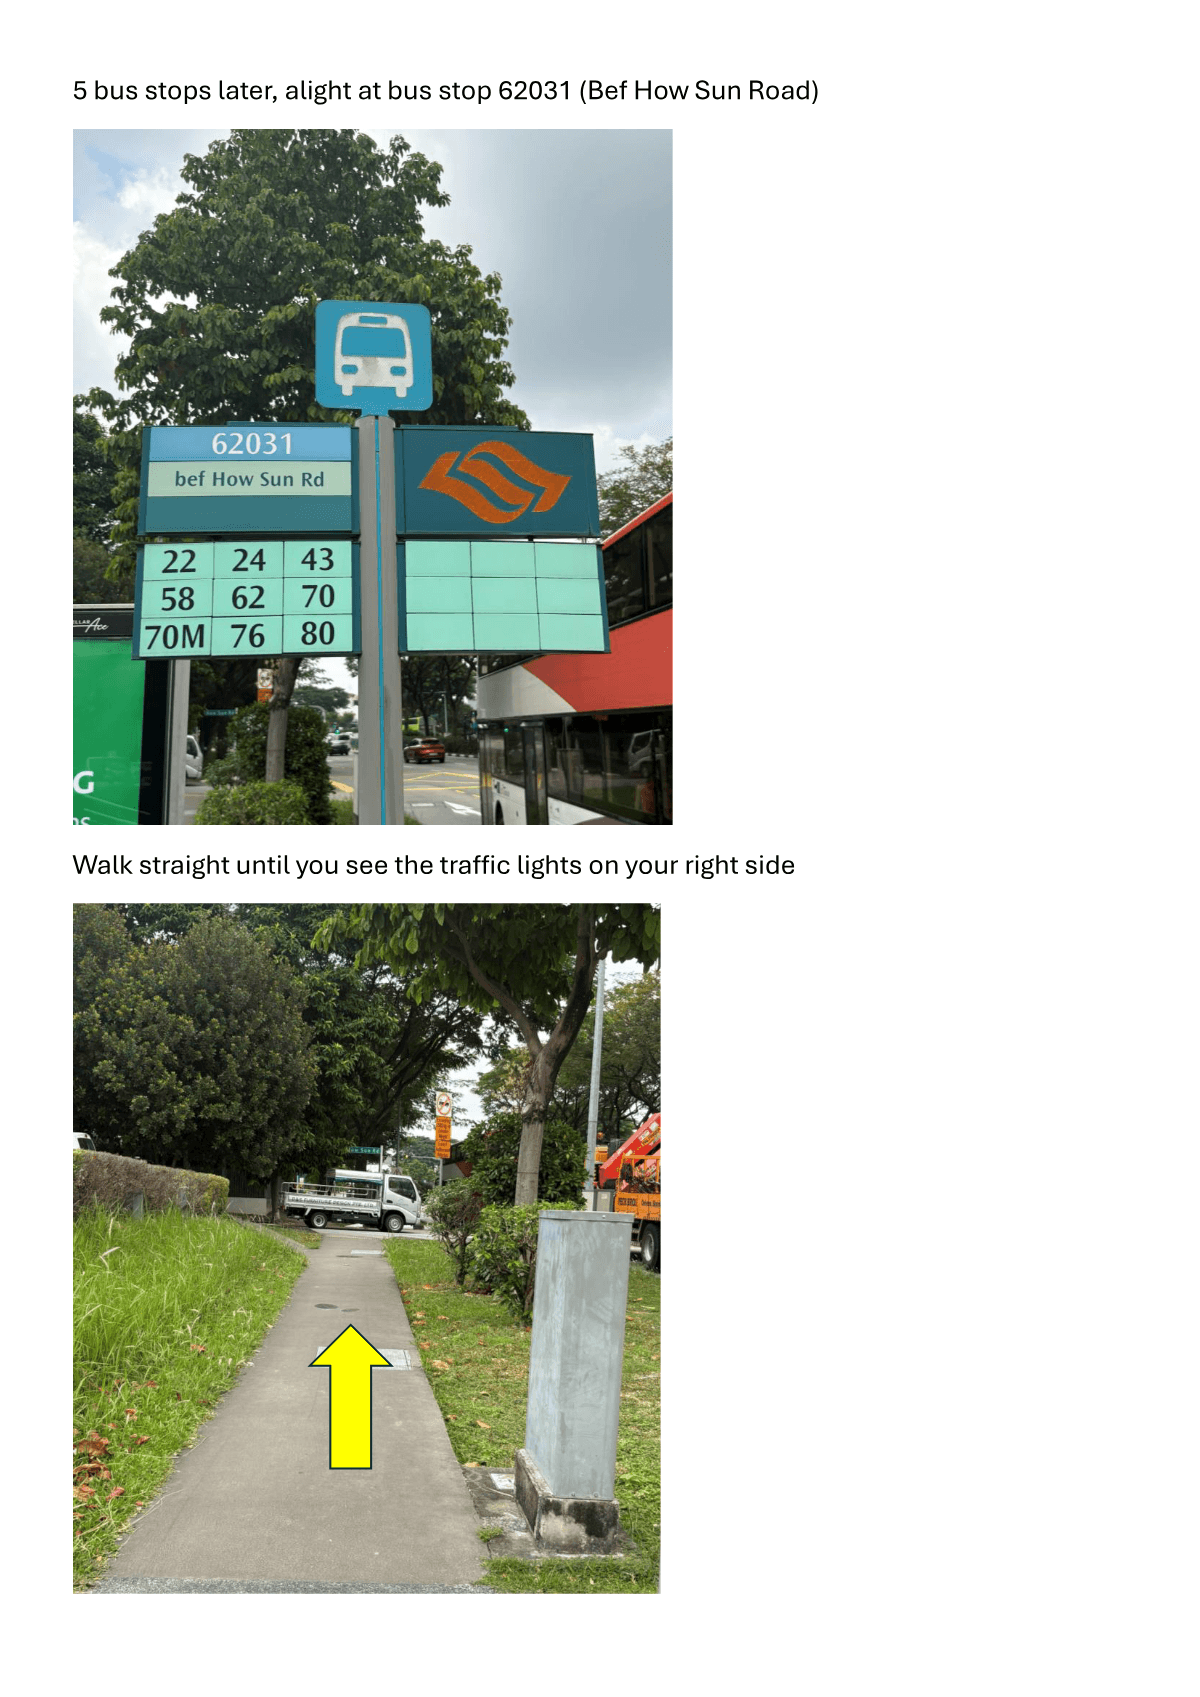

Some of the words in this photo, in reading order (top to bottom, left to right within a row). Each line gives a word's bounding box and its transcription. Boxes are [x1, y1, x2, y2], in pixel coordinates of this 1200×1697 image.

[212, 433, 294, 455] 62031
[175, 471, 206, 487] bef
[213, 471, 254, 487] How
[261, 471, 294, 487] Sun
[302, 471, 324, 487] Rd
[161, 549, 196, 573] 22
[232, 548, 266, 572] 24
[301, 547, 334, 571] 43
[161, 586, 195, 611] 58
[231, 585, 265, 610] 62
[302, 584, 335, 608] 70
[85, 617, 109, 633] Ace
[145, 623, 204, 650] 70M
[230, 623, 265, 648] 76
[301, 621, 335, 646] 80
